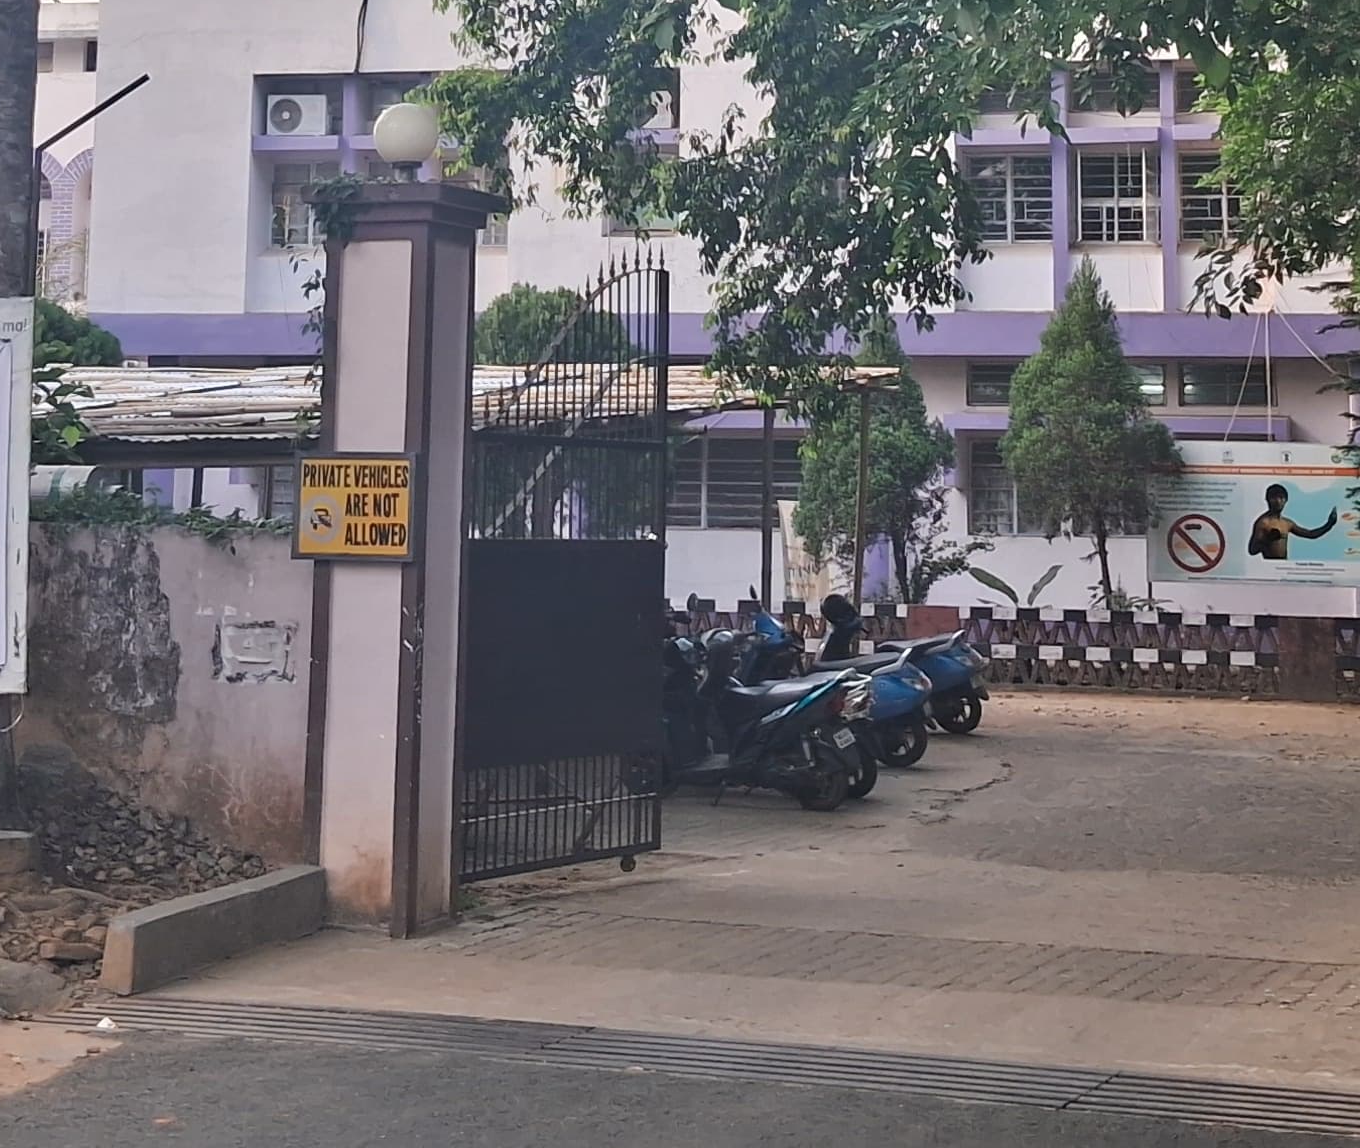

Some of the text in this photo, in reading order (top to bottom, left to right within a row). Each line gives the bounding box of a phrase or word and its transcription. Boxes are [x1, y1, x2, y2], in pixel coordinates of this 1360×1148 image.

[302, 463, 409, 489] PRIVATE VEHICLES
[344, 492, 400, 518] ARE NOT
[344, 522, 407, 547] ALLOWED
